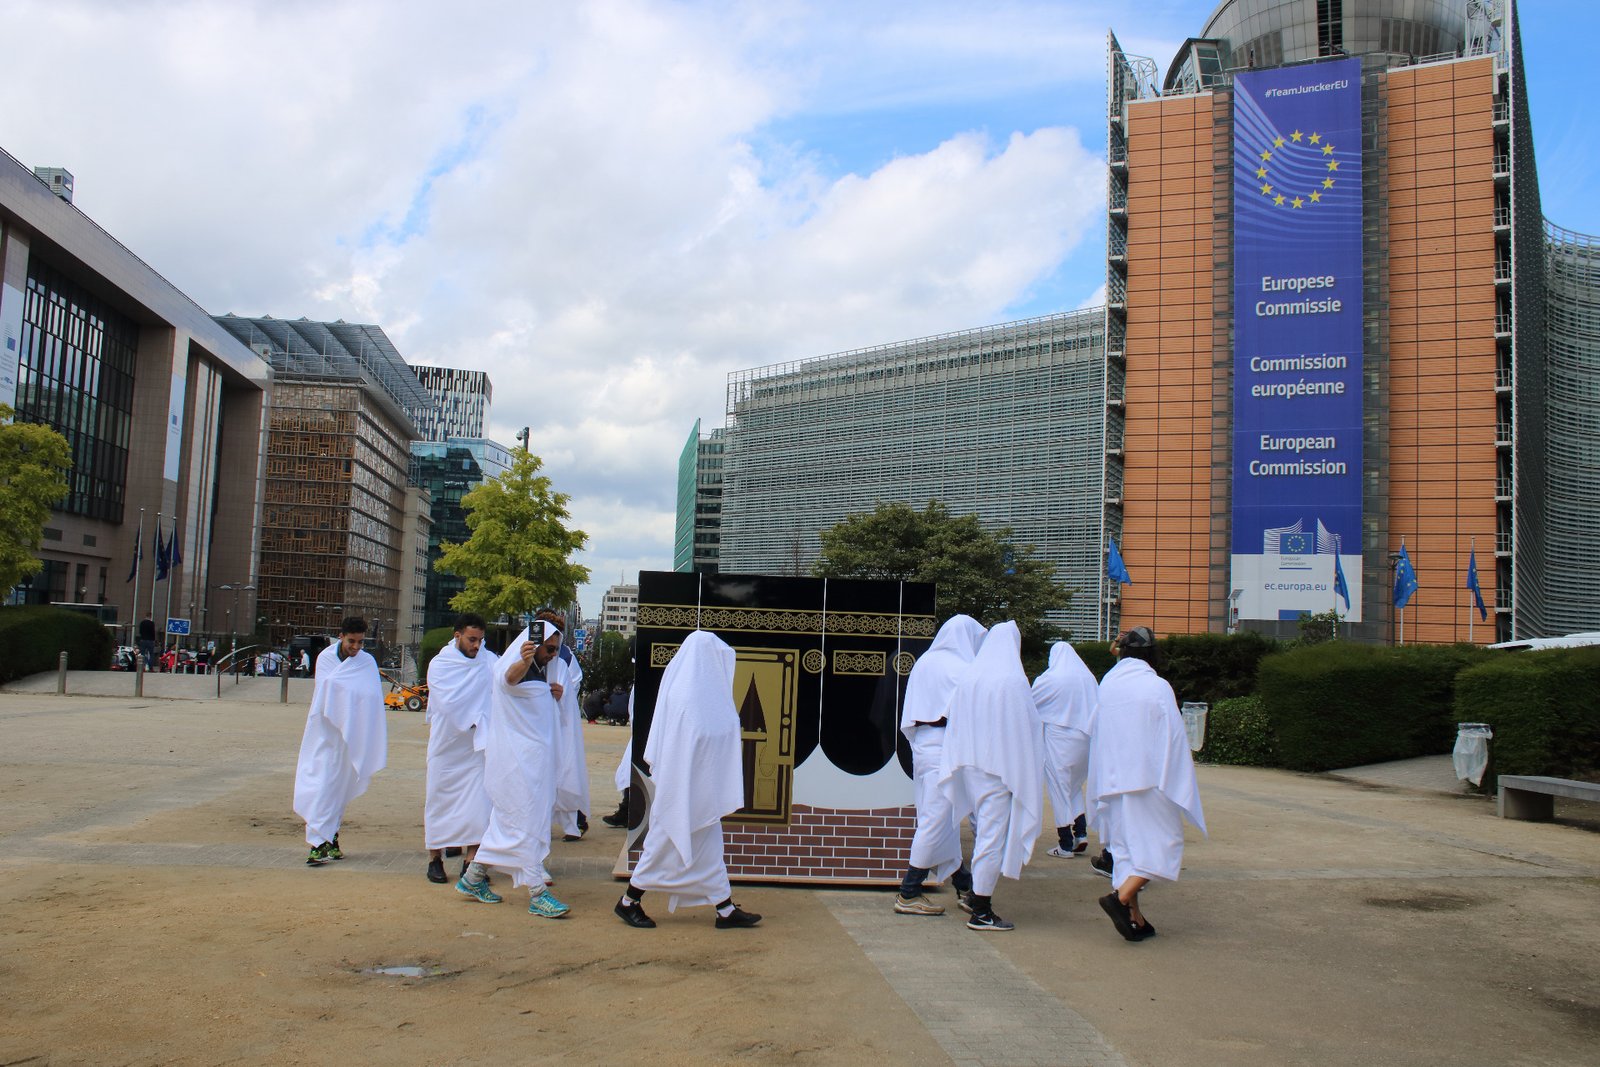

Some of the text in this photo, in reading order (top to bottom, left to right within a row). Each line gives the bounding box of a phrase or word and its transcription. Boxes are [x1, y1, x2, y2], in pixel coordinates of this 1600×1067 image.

[1265, 79, 1348, 98] #TeamJunckerEU
[1261, 275, 1335, 293] Europese
[1255, 297, 1341, 316] Commissie
[1250, 353, 1347, 372] Commission
[1251, 378, 1345, 399] européenne
[1260, 435, 1335, 453] European
[1249, 459, 1346, 476] Commission
[1264, 582, 1327, 592] ec.europa.eu
